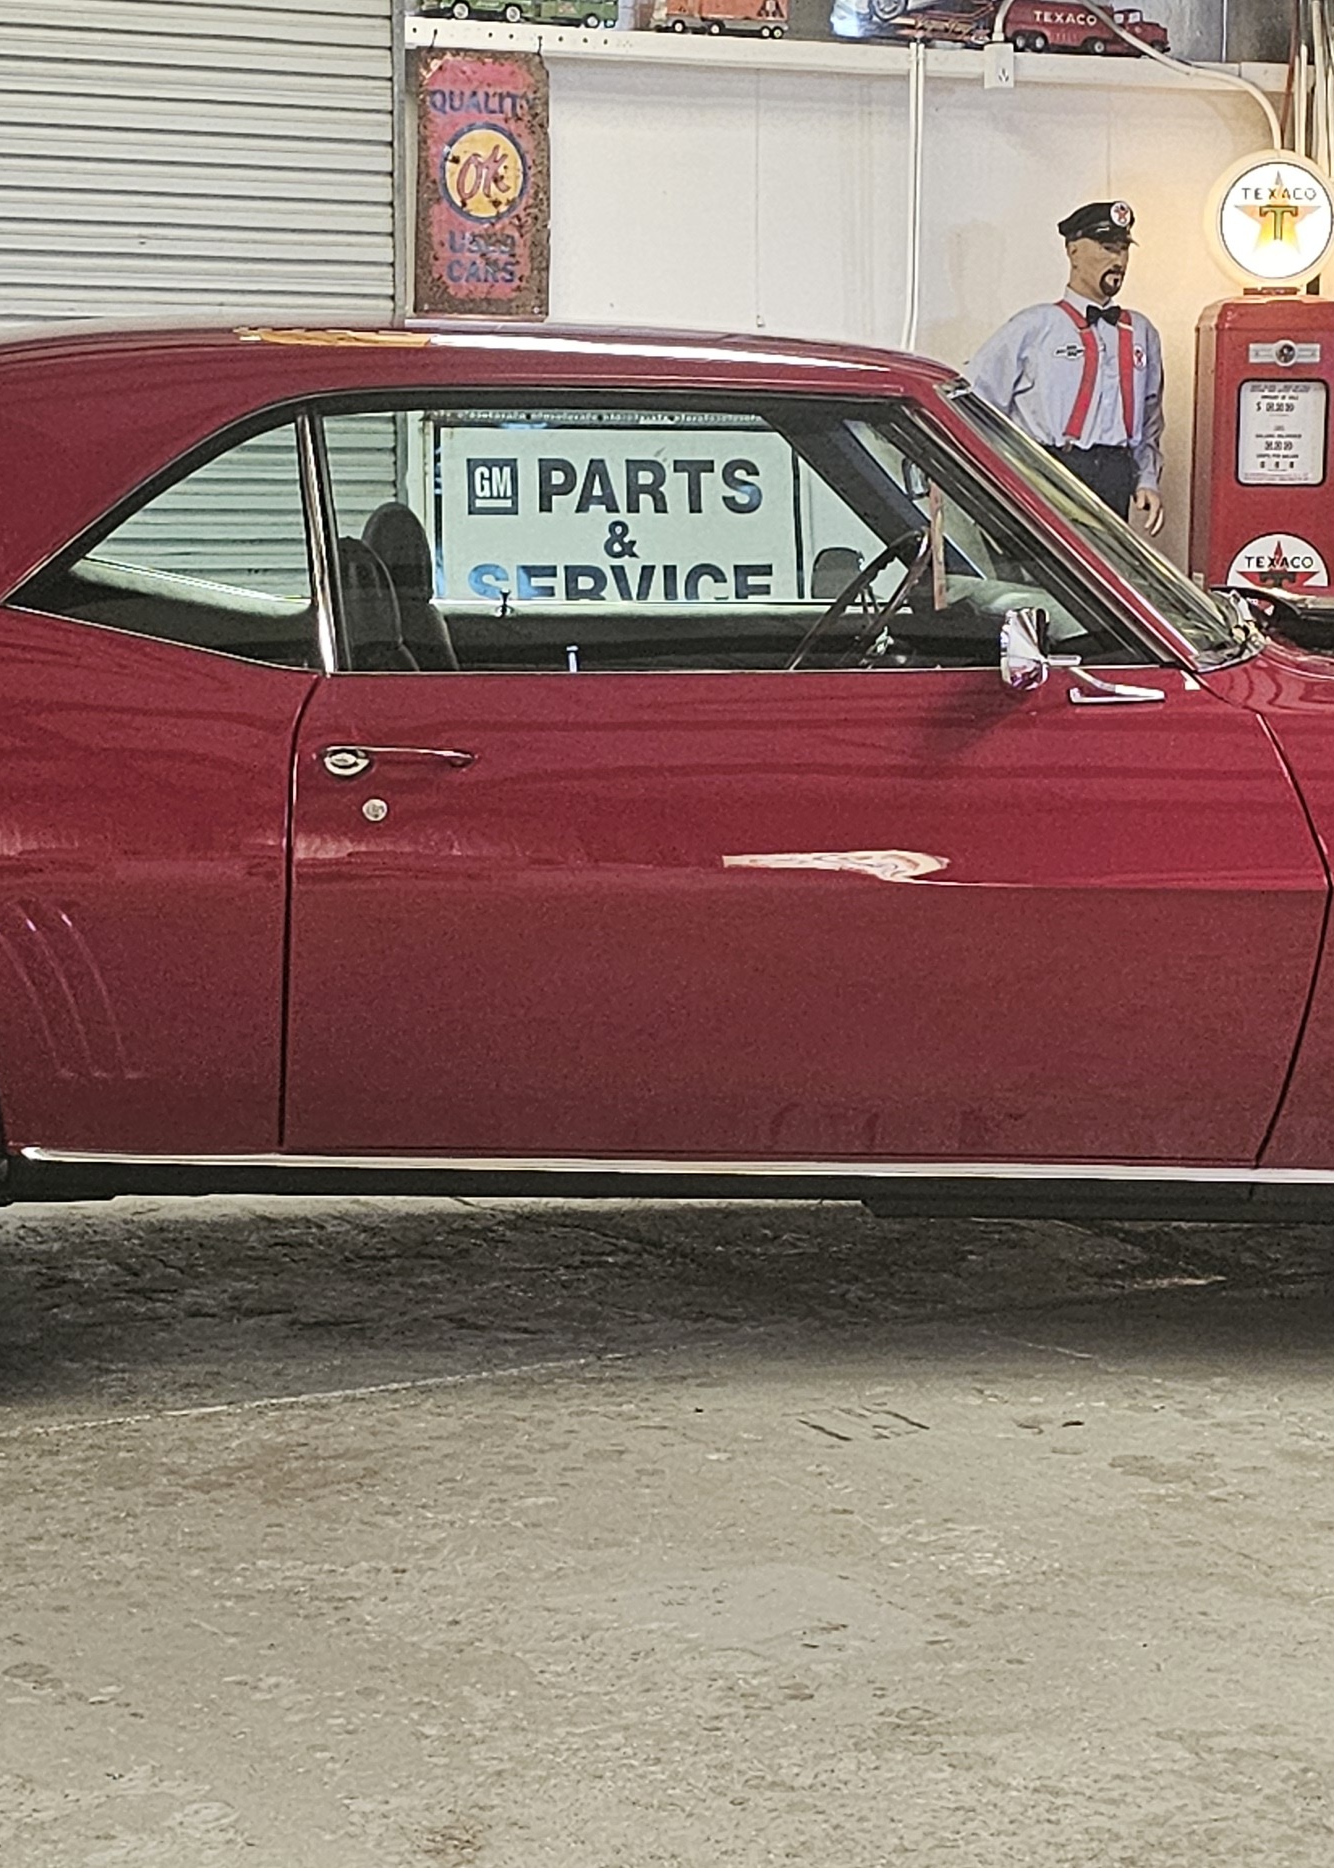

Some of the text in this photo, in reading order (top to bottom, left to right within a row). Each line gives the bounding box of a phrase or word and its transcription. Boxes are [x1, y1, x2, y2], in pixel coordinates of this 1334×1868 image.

[1033, 9, 1097, 26] TEXACO
[1241, 187, 1317, 201] TEXACO
[446, 259, 516, 283] CARS
[474, 458, 763, 514] GM PARTS
[603, 520, 640, 559] &
[1245, 555, 1314, 569] TEXACO
[468, 563, 773, 601] SERVICE
